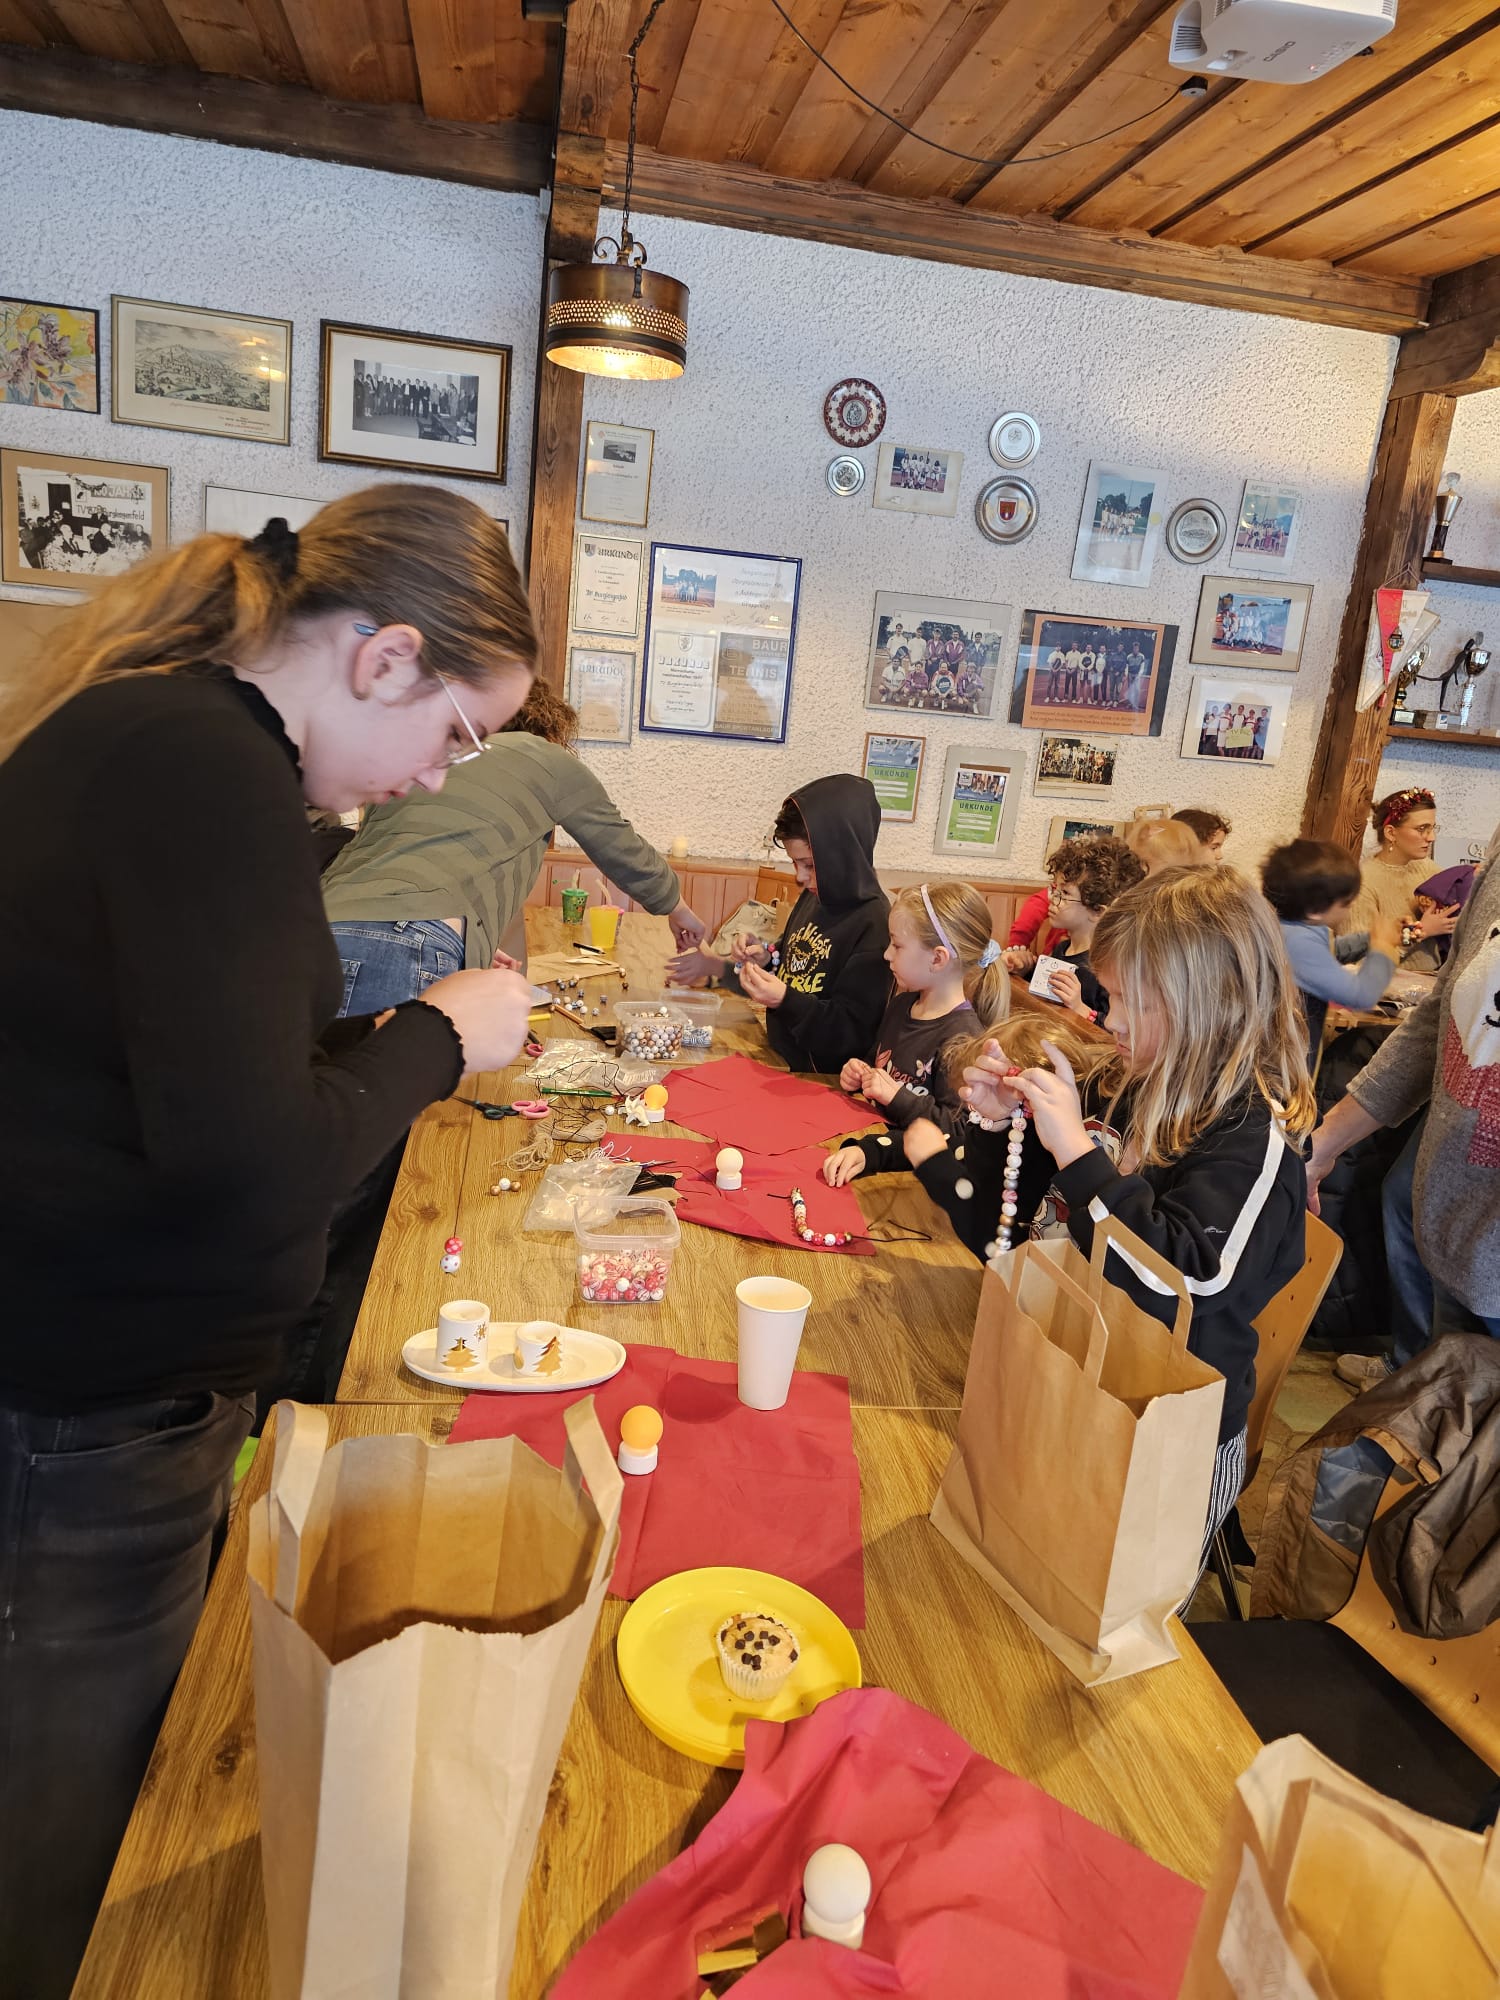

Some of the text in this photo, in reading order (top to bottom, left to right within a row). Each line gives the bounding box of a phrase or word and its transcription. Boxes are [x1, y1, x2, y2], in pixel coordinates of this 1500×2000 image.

[1263, 40, 1296, 62] CASIO
[598, 547, 639, 560] URKUNDE
[752, 639, 788, 653] BAUR
[729, 664, 778, 680] TENNIS
[873, 769, 910, 778] URKUNDE
[959, 803, 994, 812] URKUNDE
